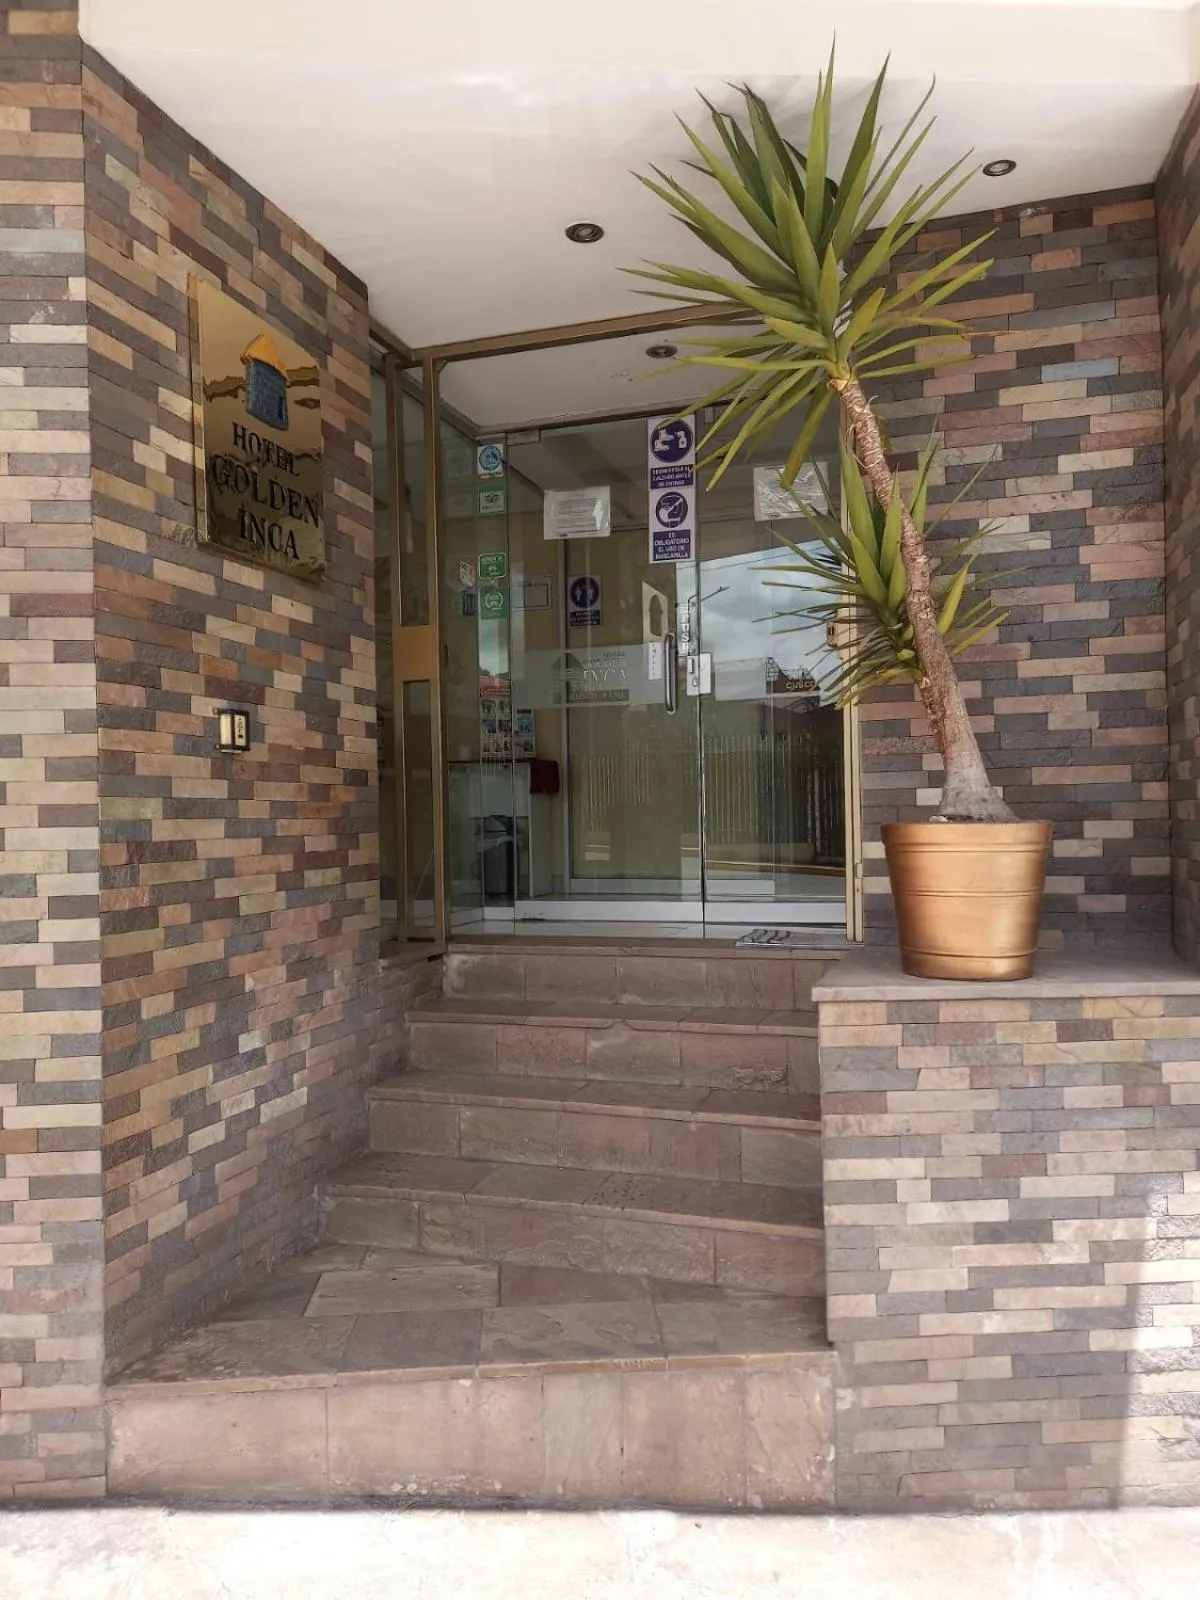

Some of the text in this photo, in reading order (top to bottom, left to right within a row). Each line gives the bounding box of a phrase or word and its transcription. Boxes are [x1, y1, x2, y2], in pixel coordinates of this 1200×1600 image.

[232, 421, 300, 477] HOTEL
[211, 453, 323, 529] GOLDEN
[238, 507, 300, 560] INCA
[654, 537, 690, 546] OBLIGATORIO
